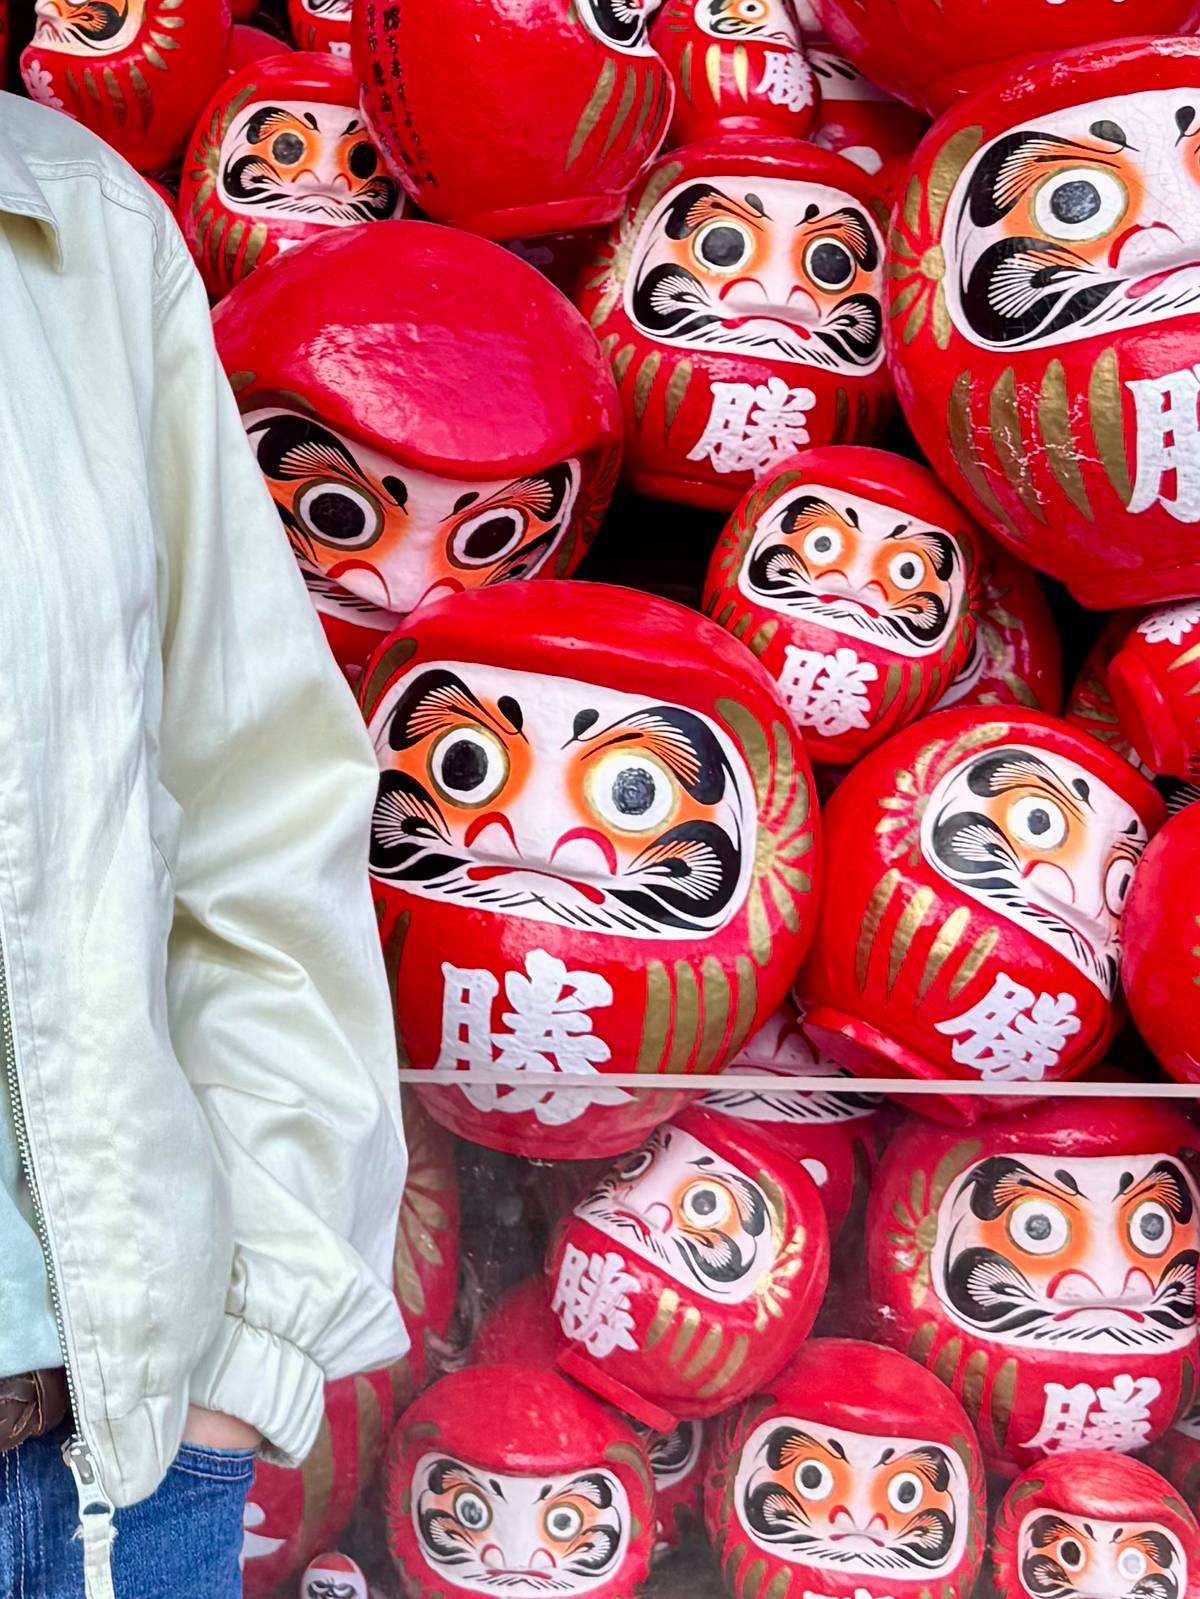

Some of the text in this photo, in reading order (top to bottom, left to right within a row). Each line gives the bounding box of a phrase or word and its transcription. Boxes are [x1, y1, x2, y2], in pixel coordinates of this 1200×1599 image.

[756, 50, 815, 113] 勝
[688, 377, 816, 478] 勝
[777, 645, 878, 737] 勝
[433, 948, 638, 1125] 勝
[934, 972, 1081, 1081] 勝
[551, 1243, 641, 1357] 勝
[1019, 1373, 1162, 1454] 勝
